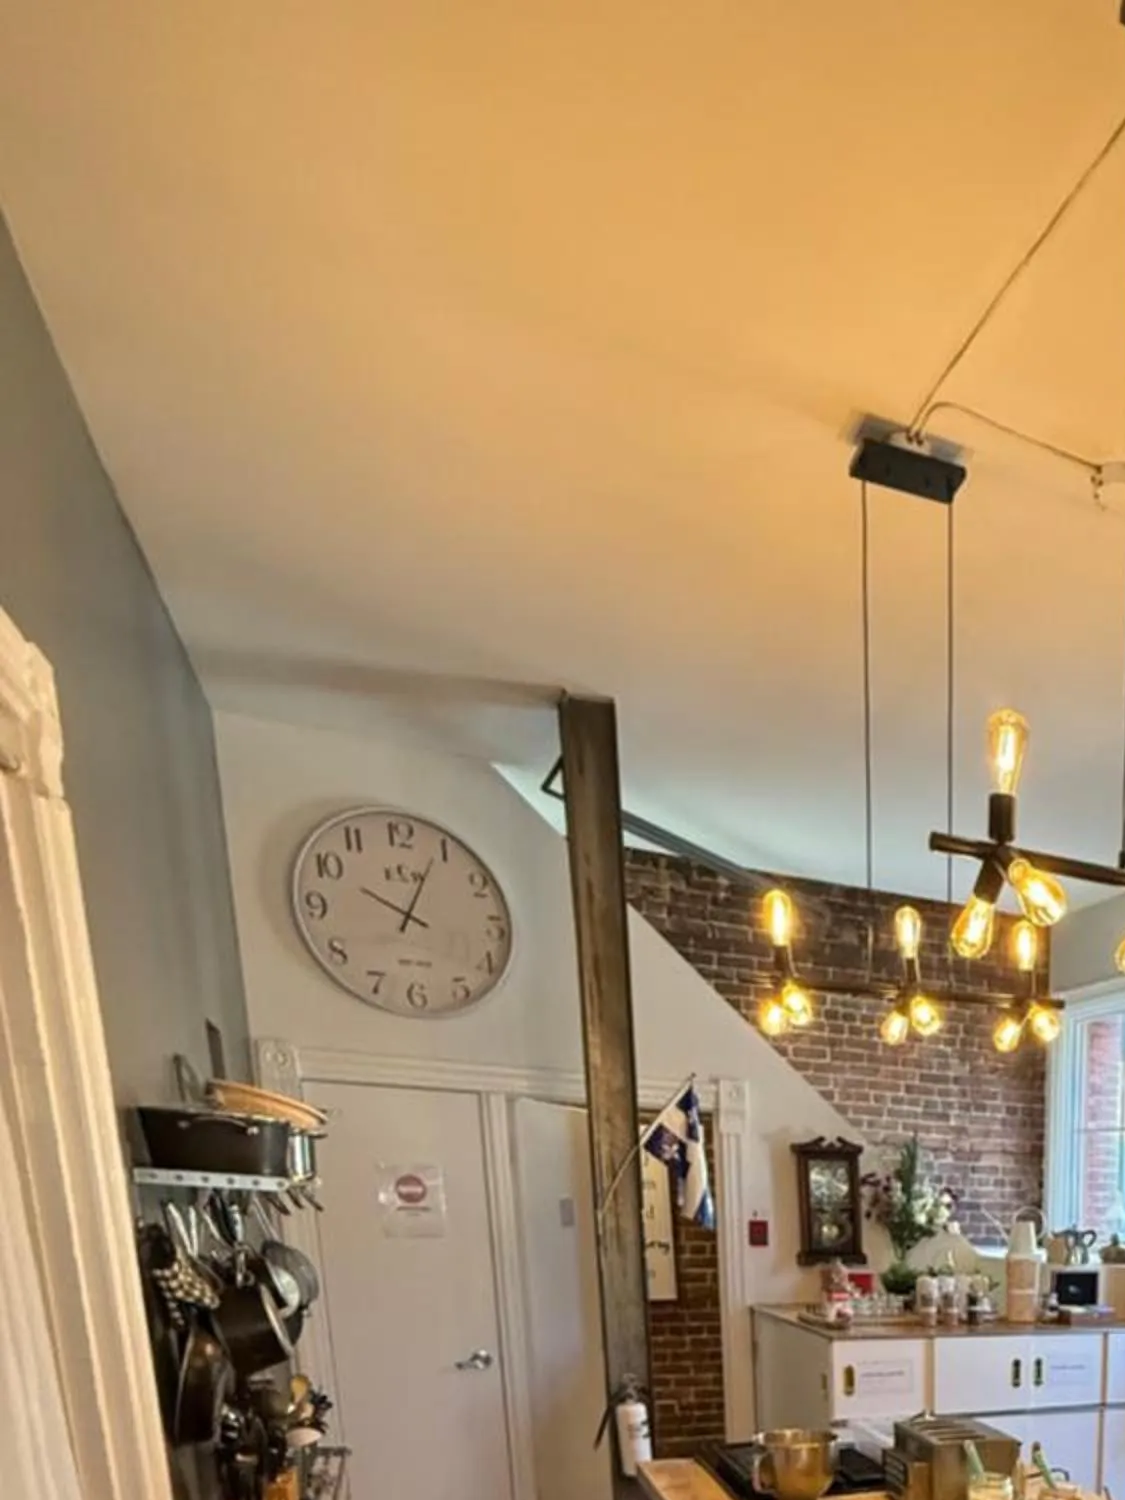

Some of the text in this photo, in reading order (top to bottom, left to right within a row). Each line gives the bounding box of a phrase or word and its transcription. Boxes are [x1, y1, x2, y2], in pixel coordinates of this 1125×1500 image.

[343, 824, 363, 854] 11
[386, 821, 415, 850] 12
[439, 838, 448, 863] 1
[315, 851, 344, 881] 10
[468, 872, 490, 899] 2
[303, 890, 328, 921] 9
[485, 914, 506, 942] 3
[327, 936, 349, 966] 8
[474, 950, 495, 977] 4
[365, 969, 387, 995] 7
[405, 982, 429, 1010] 6
[452, 976, 471, 1001] 5
